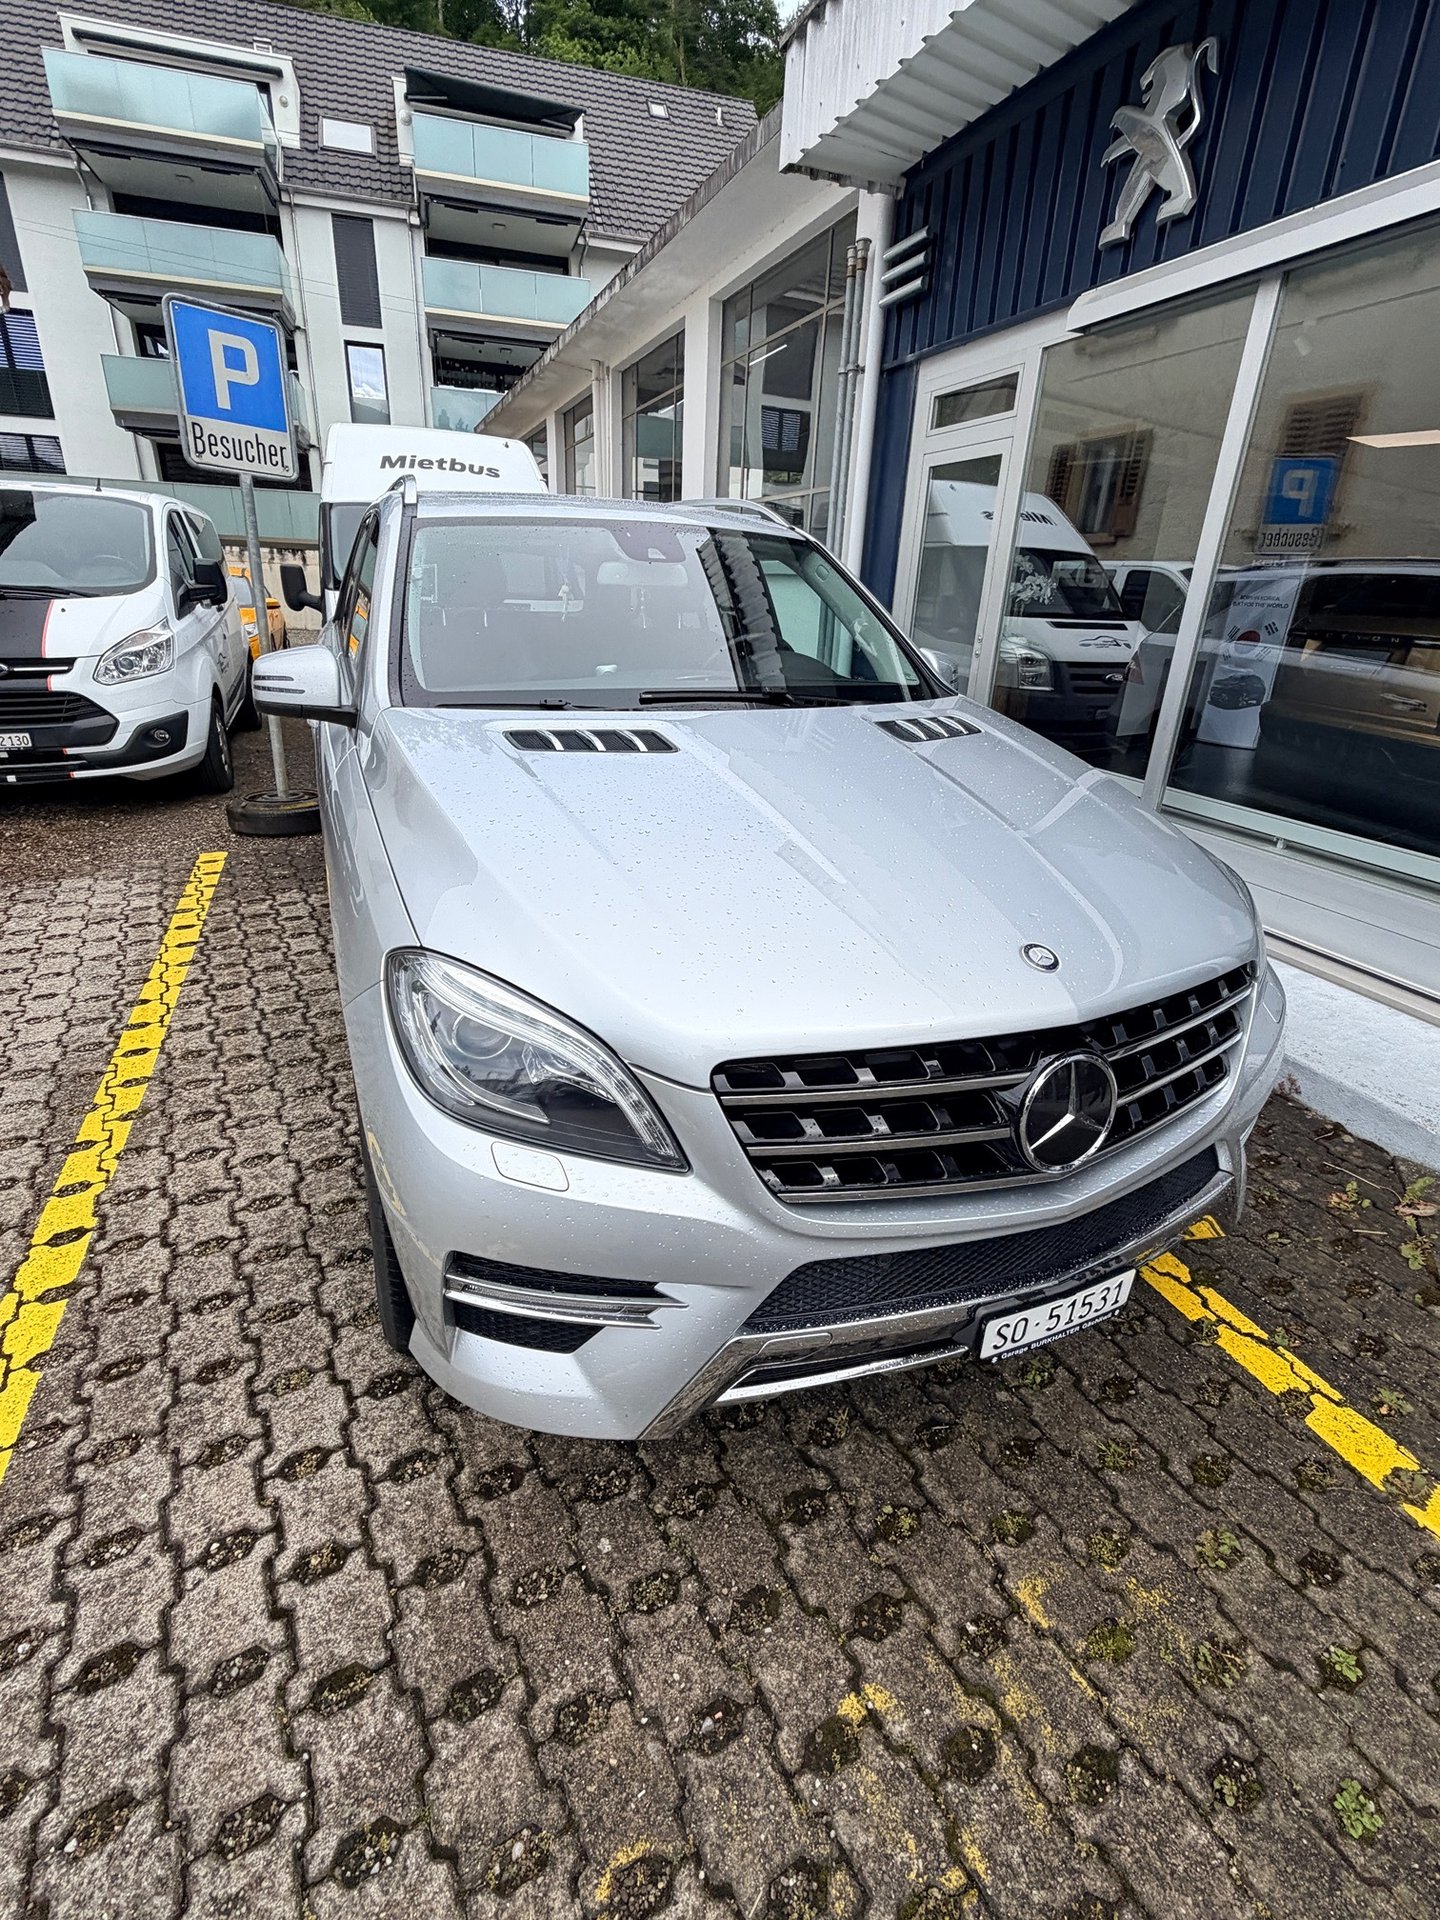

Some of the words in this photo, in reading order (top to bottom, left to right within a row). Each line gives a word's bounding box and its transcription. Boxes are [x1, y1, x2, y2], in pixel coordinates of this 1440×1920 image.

[207, 328, 260, 411] P
[191, 421, 287, 468] Besucher
[380, 455, 500, 478] Mietbus
[1001, 1346, 1029, 1360] Garage
[1030, 1326, 1080, 1350] BURKHALTER
